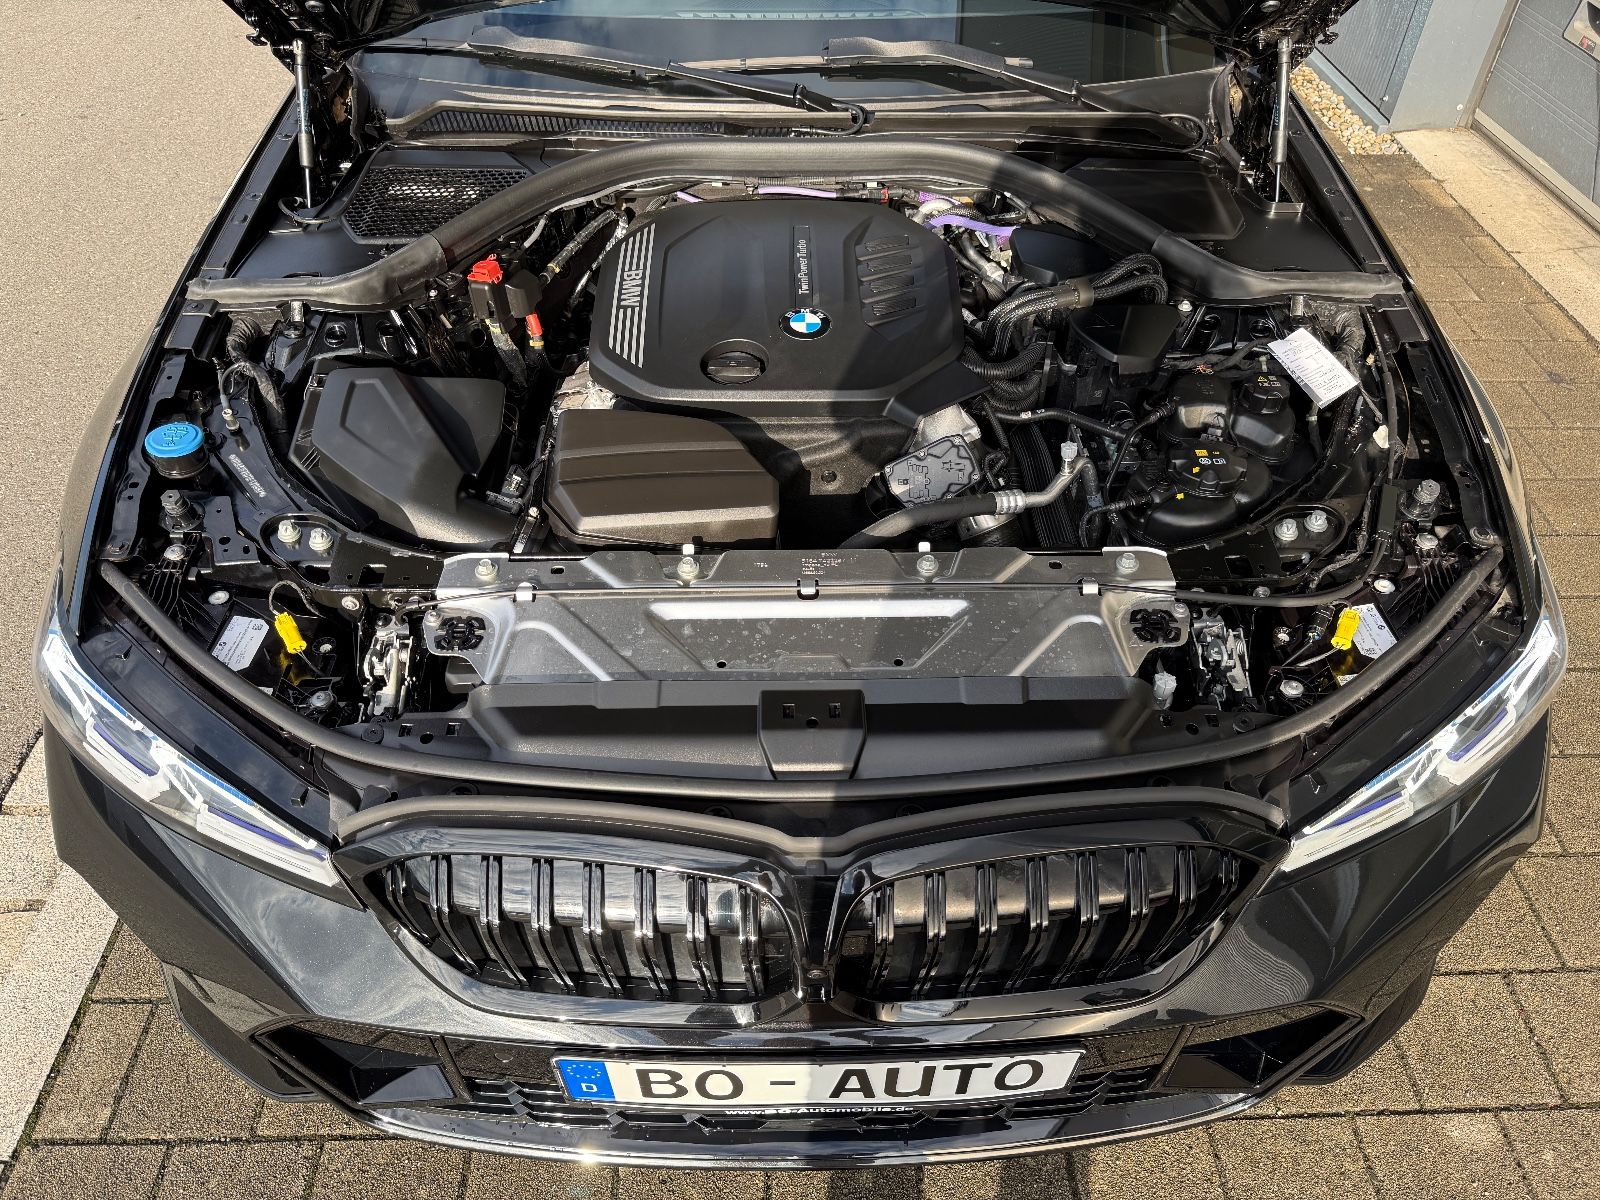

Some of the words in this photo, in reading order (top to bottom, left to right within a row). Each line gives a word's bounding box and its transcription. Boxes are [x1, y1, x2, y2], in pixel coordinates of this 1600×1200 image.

[797, 239, 807, 257] Turbo
[620, 269, 644, 307] BMW
[798, 258, 810, 295] TwinPower
[581, 1083, 598, 1093] D
[635, 1068, 744, 1101] BO
[828, 1059, 1044, 1099] AUTO
[724, 1105, 914, 1116] www.BO-Automobile.de
